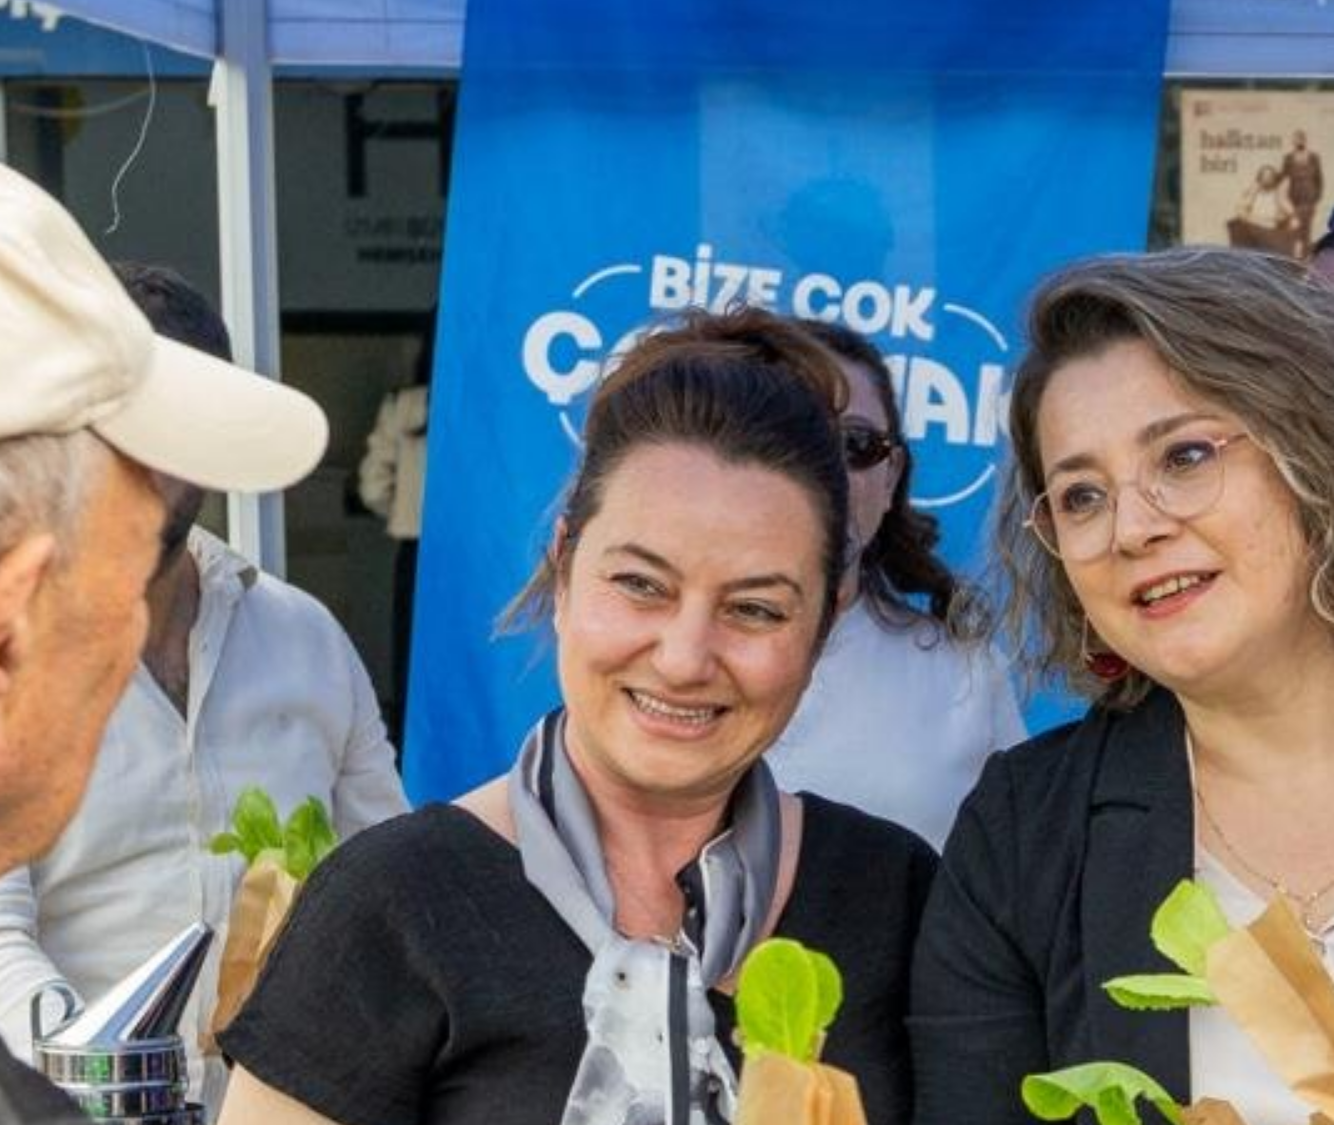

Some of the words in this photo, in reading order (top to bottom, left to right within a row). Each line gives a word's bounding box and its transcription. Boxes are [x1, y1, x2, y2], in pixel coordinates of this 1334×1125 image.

[1199, 129, 1283, 149] halktan
[1200, 155, 1238, 173] biri
[649, 244, 783, 318] BİZE
